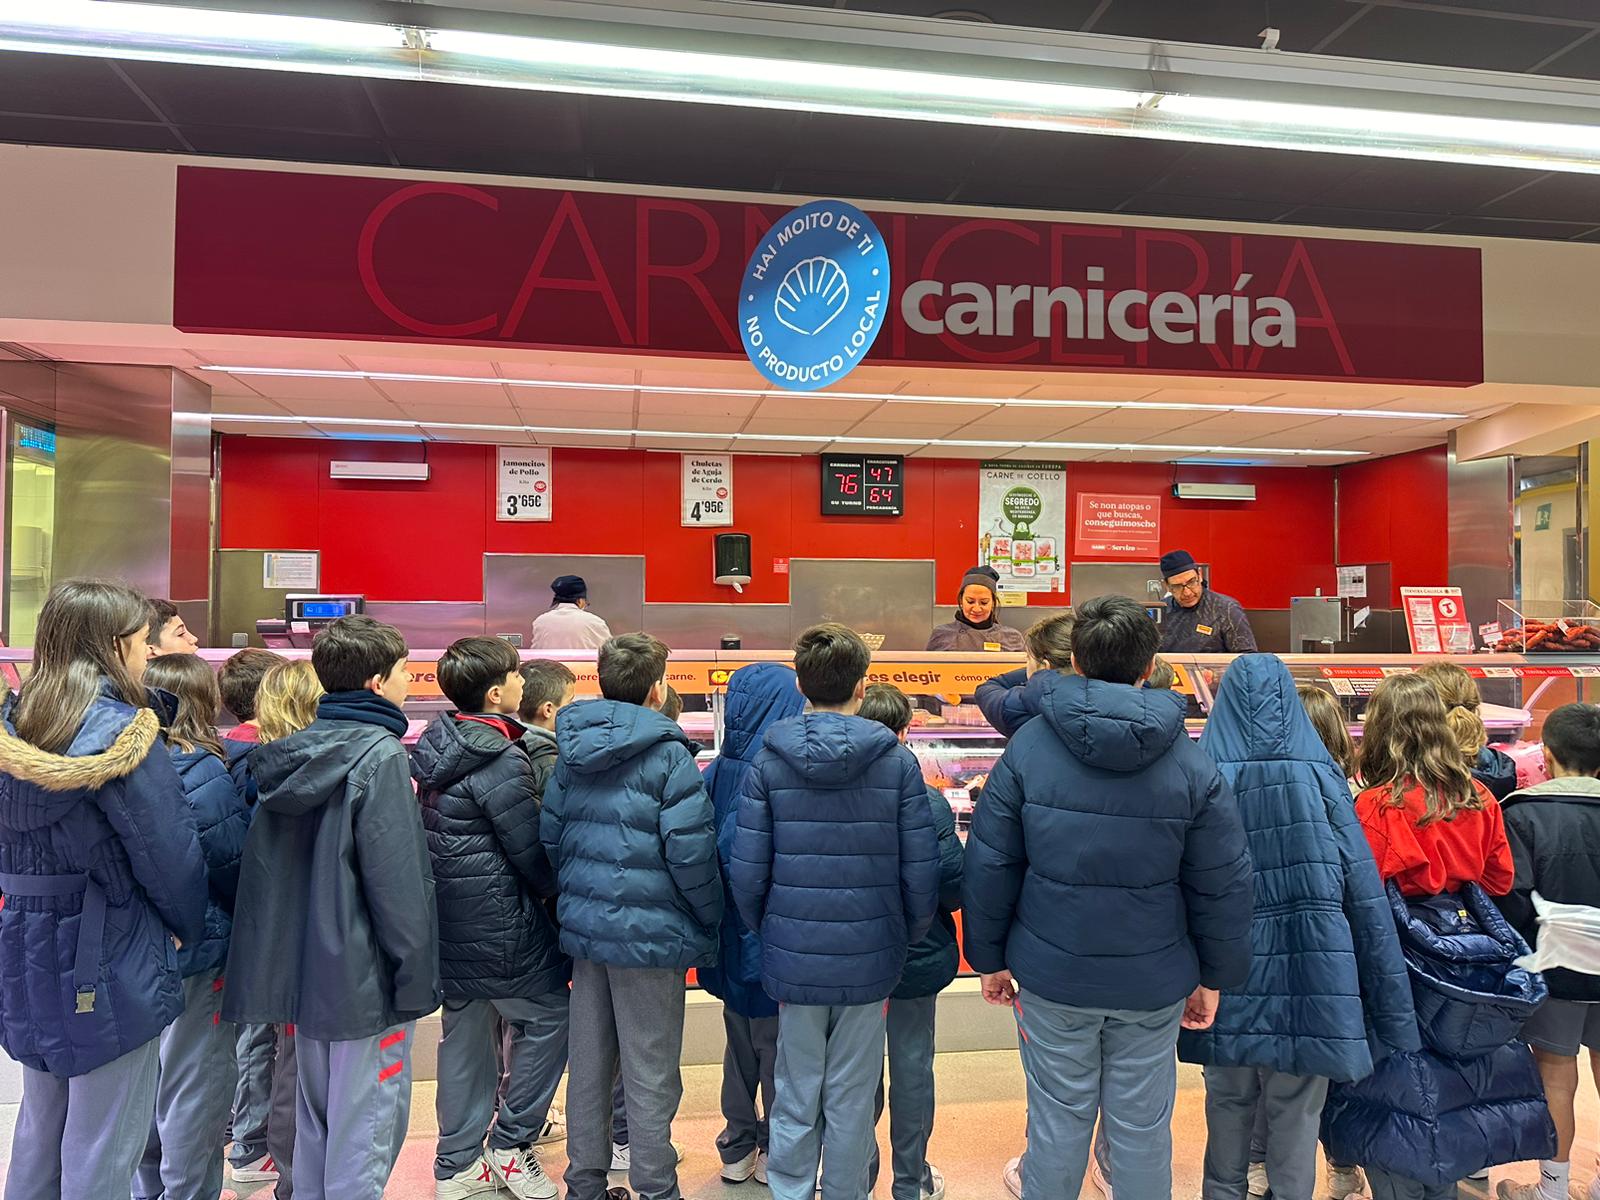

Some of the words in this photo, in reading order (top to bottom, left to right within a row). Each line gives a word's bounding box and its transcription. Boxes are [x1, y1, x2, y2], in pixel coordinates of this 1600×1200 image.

[752, 244, 777, 280] HAI
[776, 211, 833, 246] MOITO
[836, 215, 861, 240] DE
[857, 233, 874, 256] TI
[901, 266, 1296, 348] carnicería
[747, 315, 763, 346] NO
[758, 346, 843, 382] PRODUCTO
[844, 290, 880, 359] LOCAL
[871, 467, 893, 482] 47
[987, 471, 1014, 479] CARNE
[1027, 472, 1060, 480] COELLO
[835, 473, 858, 494] 76
[869, 487, 892, 503] 64
[1005, 497, 1039, 506] SEGREDO
[1118, 502, 1144, 511] atopas
[1097, 511, 1112, 519] que
[1114, 511, 1142, 519] buscas,
[1085, 519, 1156, 528] conseguímoscho
[893, 671, 941, 685] elegir
